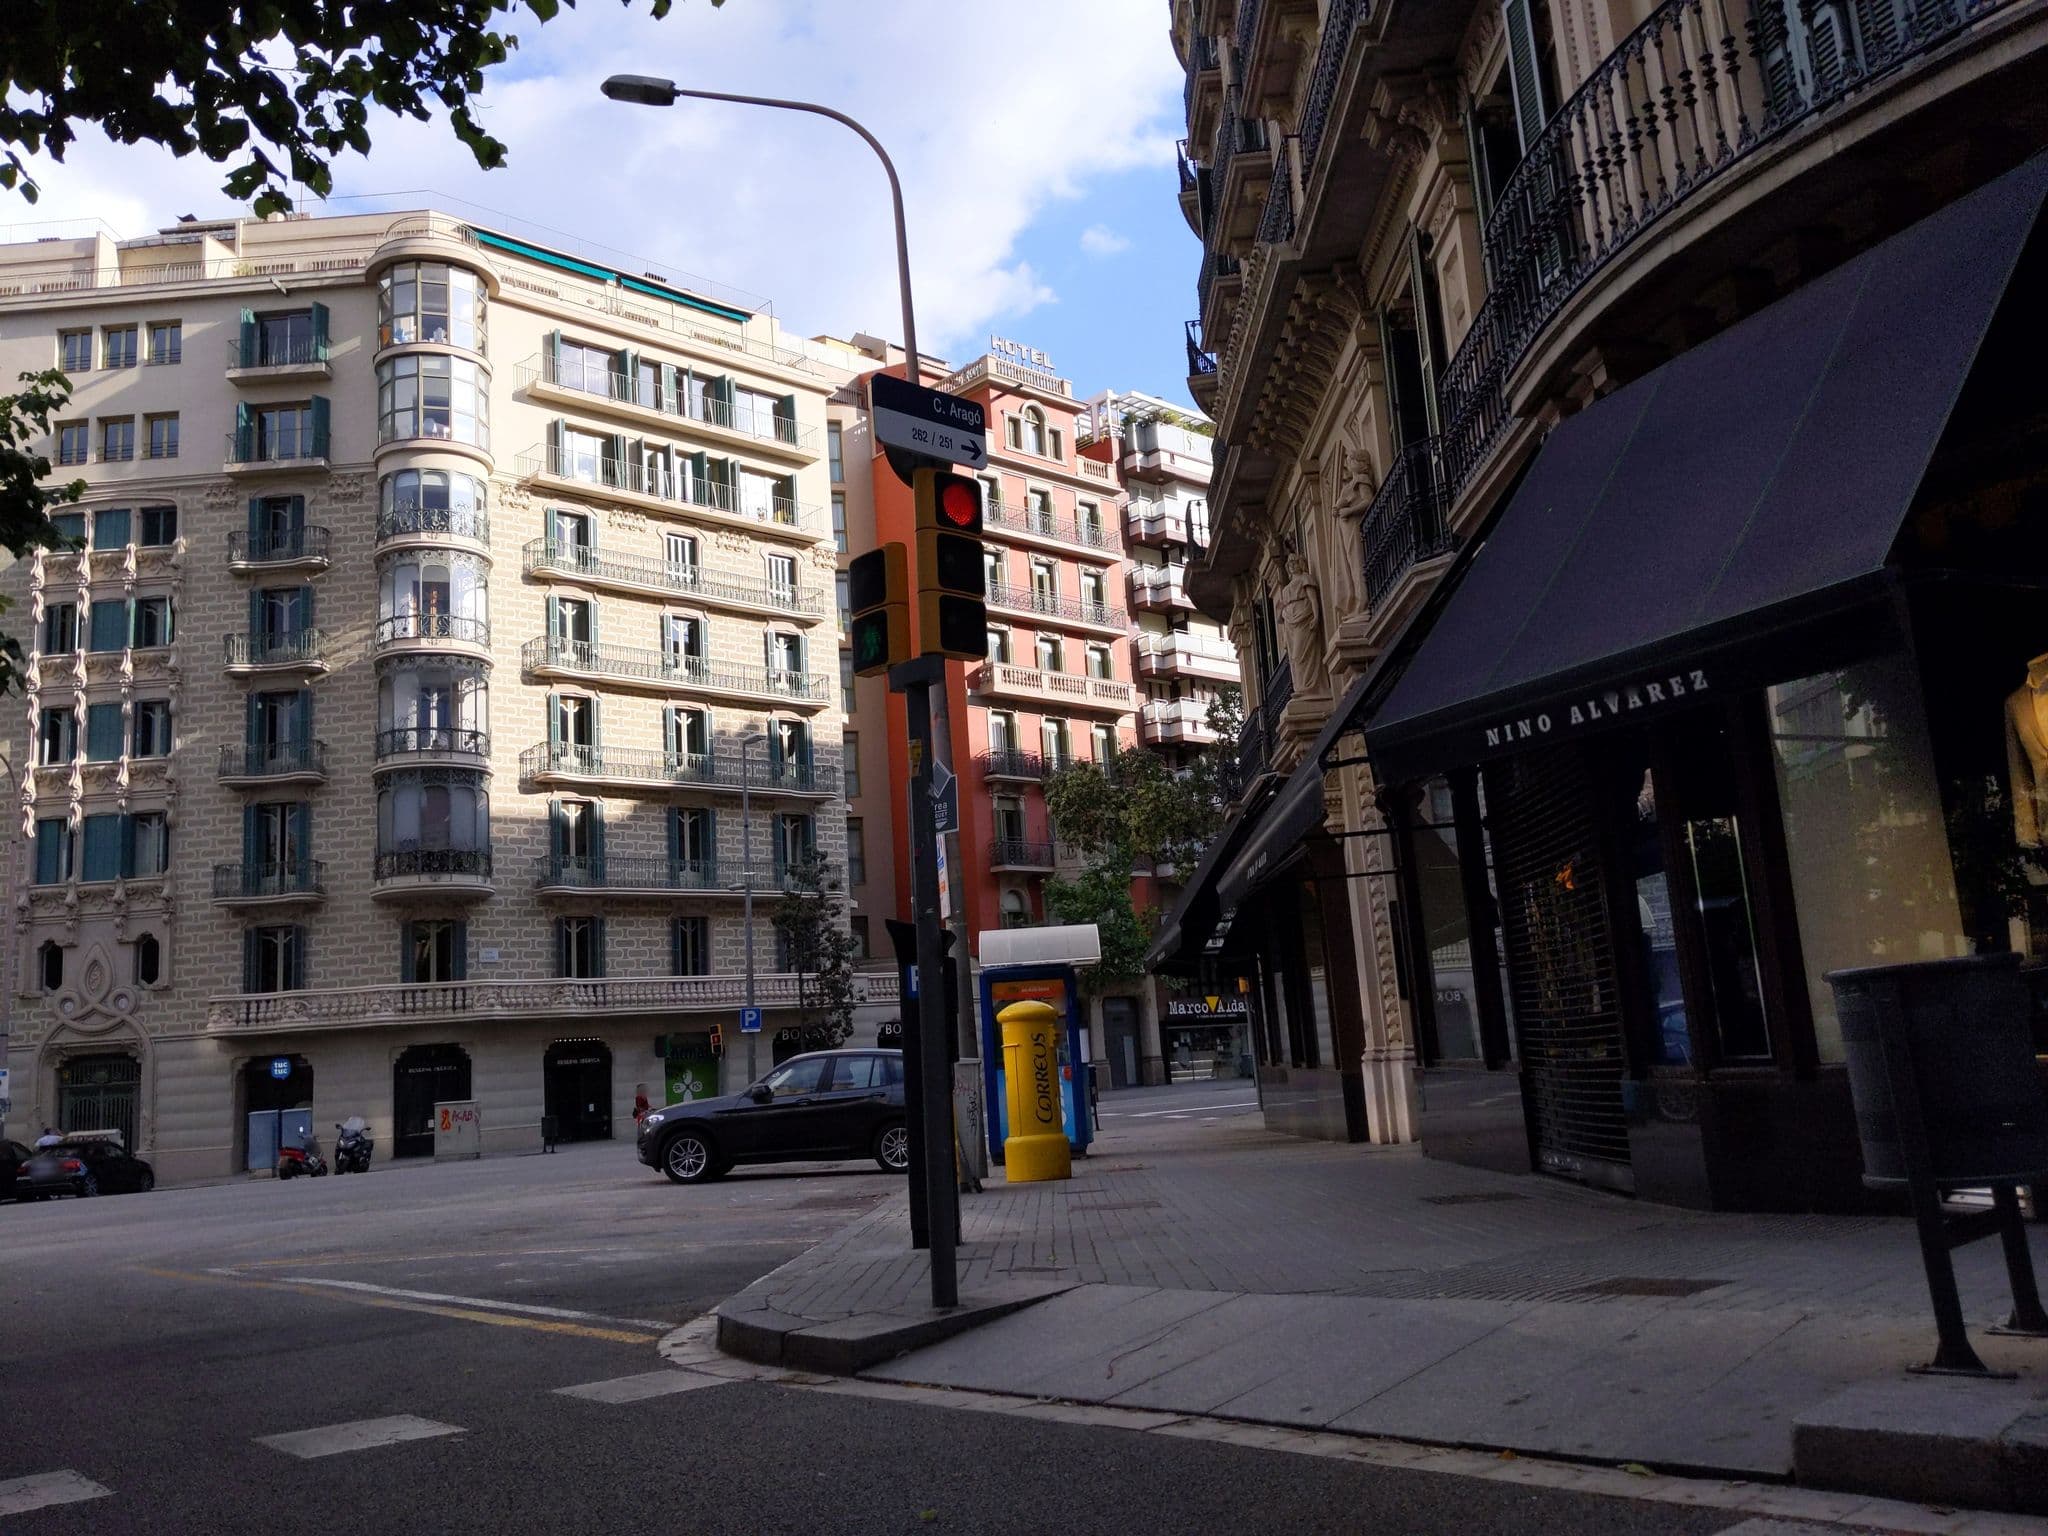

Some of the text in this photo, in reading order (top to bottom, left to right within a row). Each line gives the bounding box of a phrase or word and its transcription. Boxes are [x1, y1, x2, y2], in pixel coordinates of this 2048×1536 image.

[991, 335, 1056, 370] HOTEL
[933, 397, 981, 426] C. Aragó
[912, 427, 928, 443] 262
[939, 435, 953, 450] 251
[1486, 669, 1709, 747] NINO ALVAREZ
[745, 1010, 757, 1026] P
[1168, 1000, 1209, 1015] Marco
[1030, 1032, 1053, 1123] CORREUS
